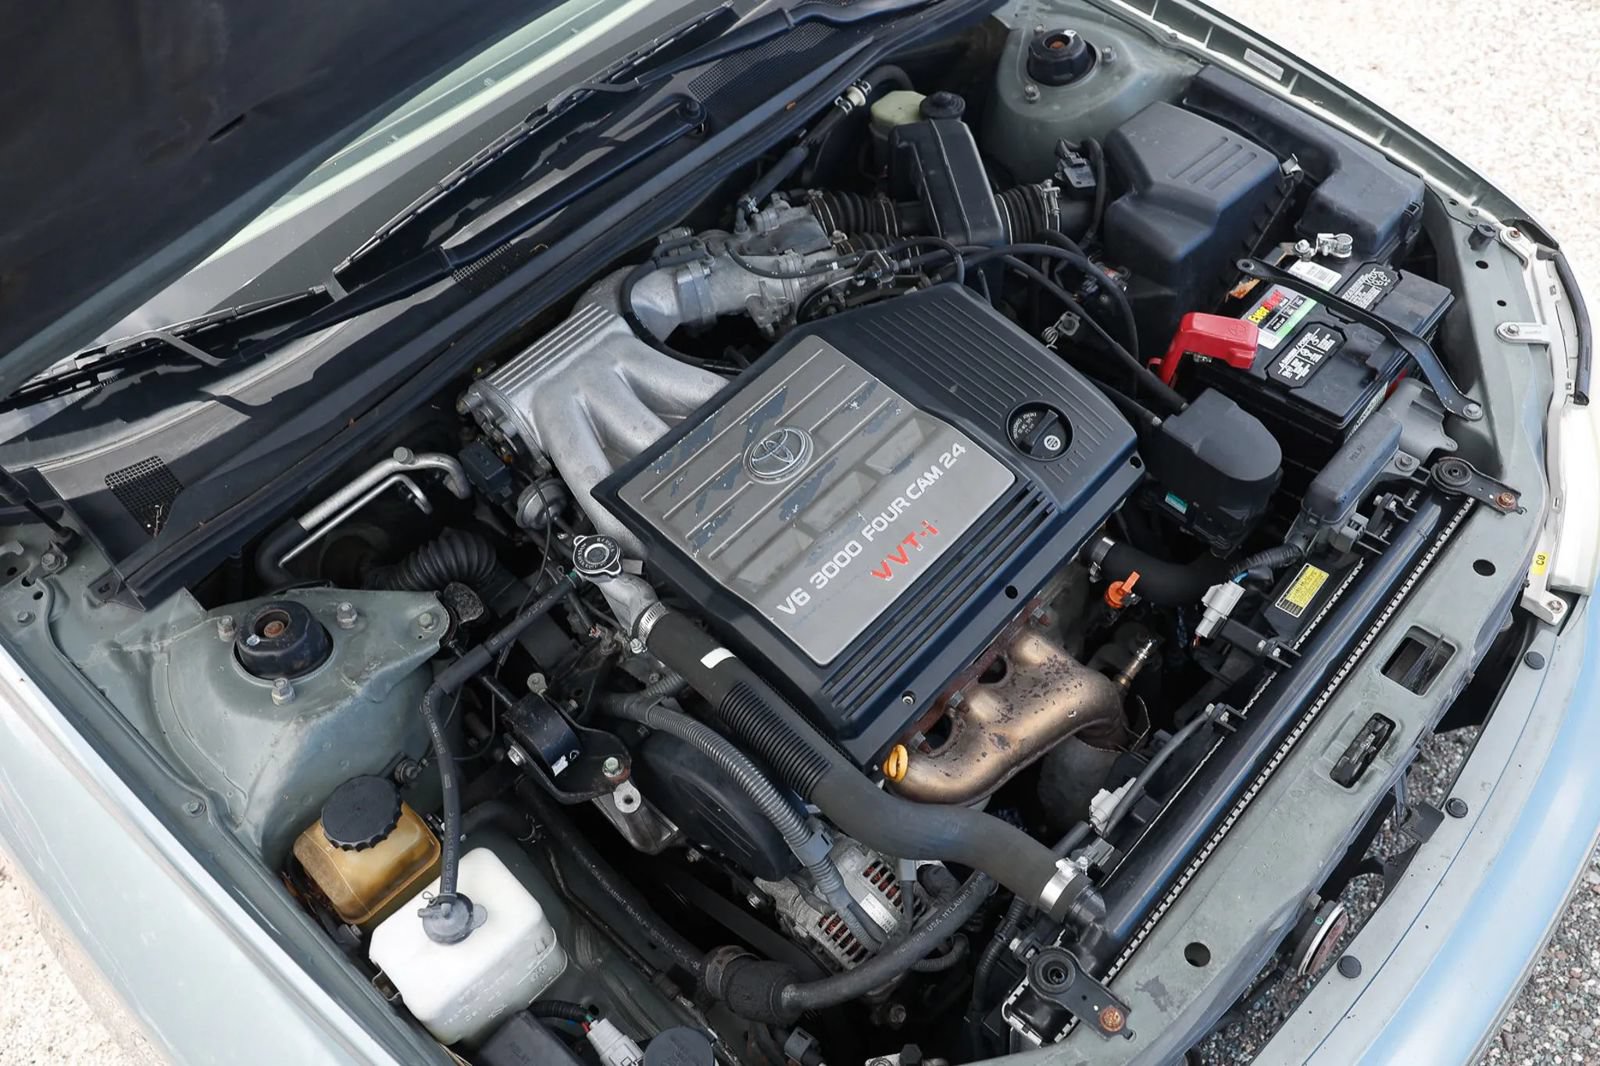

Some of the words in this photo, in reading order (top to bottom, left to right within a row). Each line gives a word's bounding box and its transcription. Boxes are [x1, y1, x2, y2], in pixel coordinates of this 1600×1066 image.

[776, 587, 811, 615] V6
[809, 540, 863, 590] 3000
[861, 496, 911, 542] FOUR
[905, 466, 943, 500] CAM
[938, 442, 967, 469] 24
